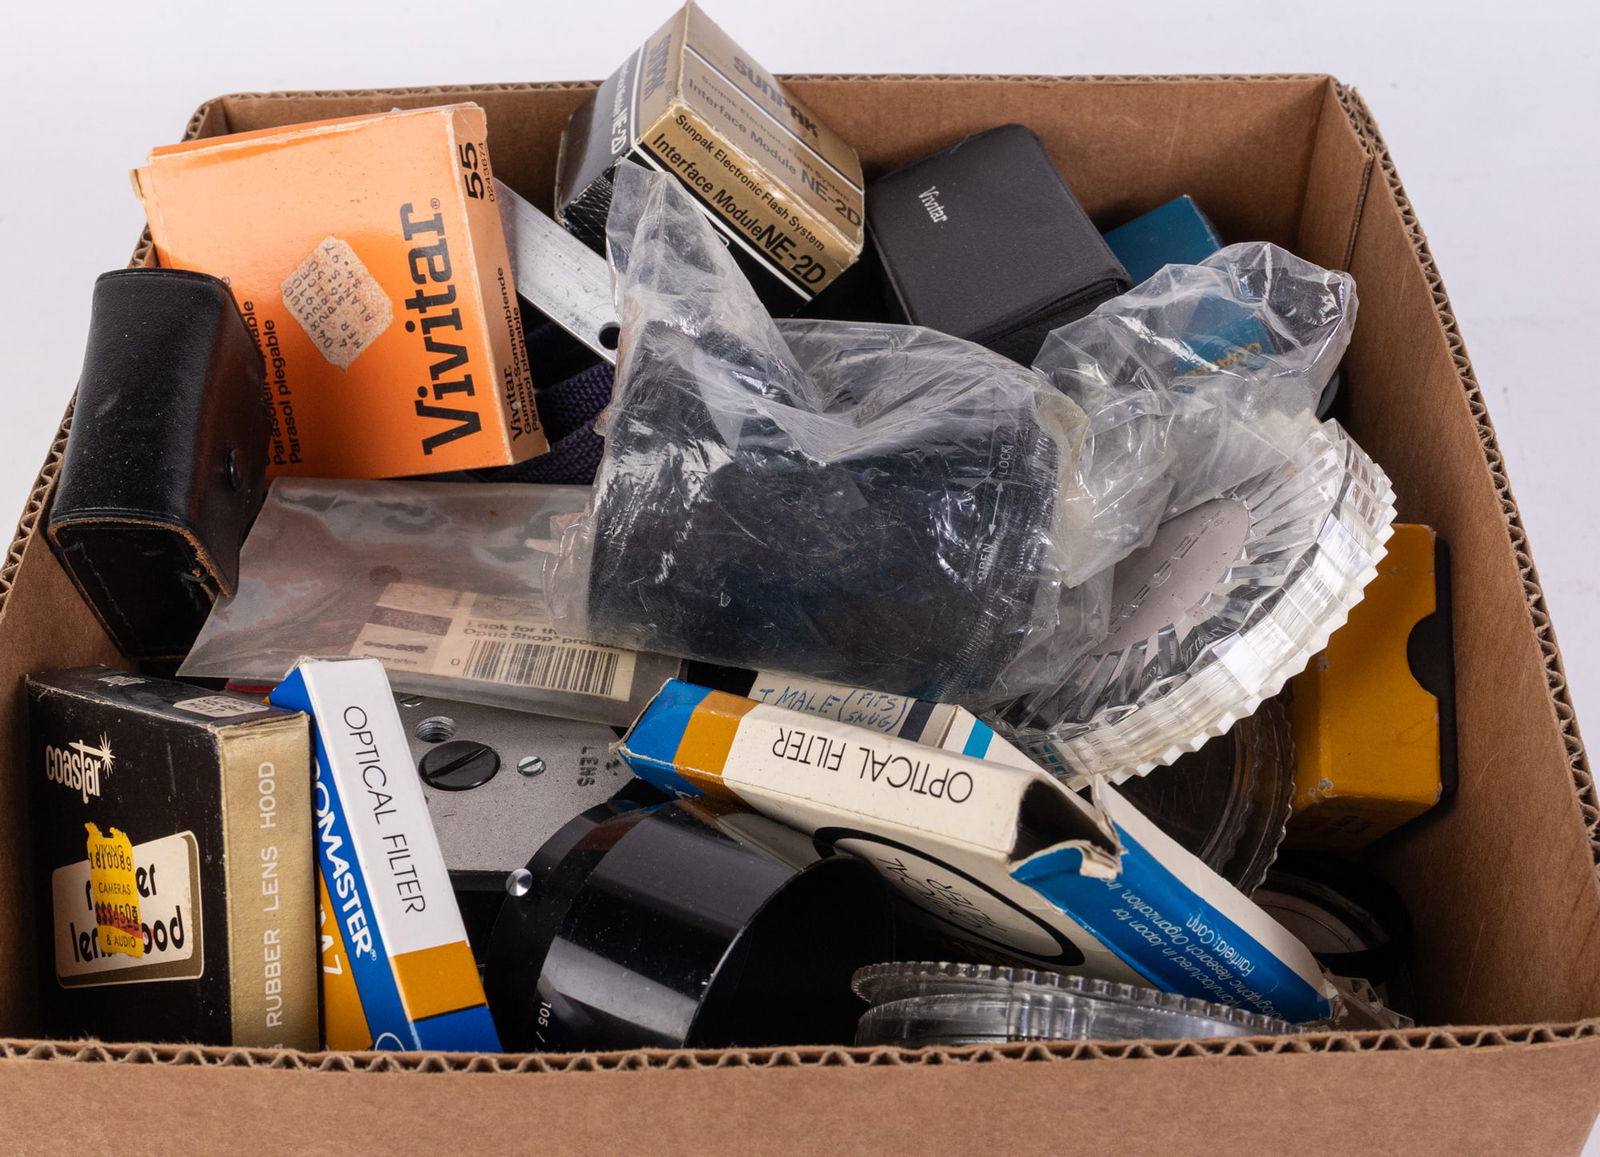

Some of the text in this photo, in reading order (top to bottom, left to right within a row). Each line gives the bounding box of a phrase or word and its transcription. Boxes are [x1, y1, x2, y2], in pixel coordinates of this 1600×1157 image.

[461, 141, 486, 201] 55
[675, 114, 826, 252] Sunpak Electronic Flash System
[689, 79, 747, 133] Interface
[750, 132, 796, 175] Module
[801, 170, 862, 227] NE-2D
[652, 133, 827, 287] Interface Module NE-2D
[918, 185, 948, 225] Vivitar
[497, 267, 532, 435] Gummi-Sonnenblende
[513, 307, 539, 433] Parasol plegable
[263, 319, 303, 463] Parasol plegable
[514, 622, 539, 635] for
[543, 627, 558, 636] th
[759, 687, 775, 705] T
[777, 687, 841, 713] MALE
[45, 739, 104, 804] coastar
[258, 760, 277, 830] HOOD
[772, 727, 974, 804] OPTICAL FILTER
[343, 704, 397, 824] OPTICAL
[382, 833, 426, 914] FILTER
[95, 844, 124, 858] VIKING
[261, 845, 279, 912] LENS
[98, 881, 131, 896] CAMERAS
[1112, 908, 1130, 921] for
[106, 933, 137, 949] & AUDIO
[1129, 919, 1167, 949] Japan
[1162, 947, 1174, 958] in
[1186, 912, 1216, 945] Conn.
[265, 927, 283, 1027] RUBBER
[1185, 943, 1234, 981] Research
[538, 1001, 552, 1028] 105
